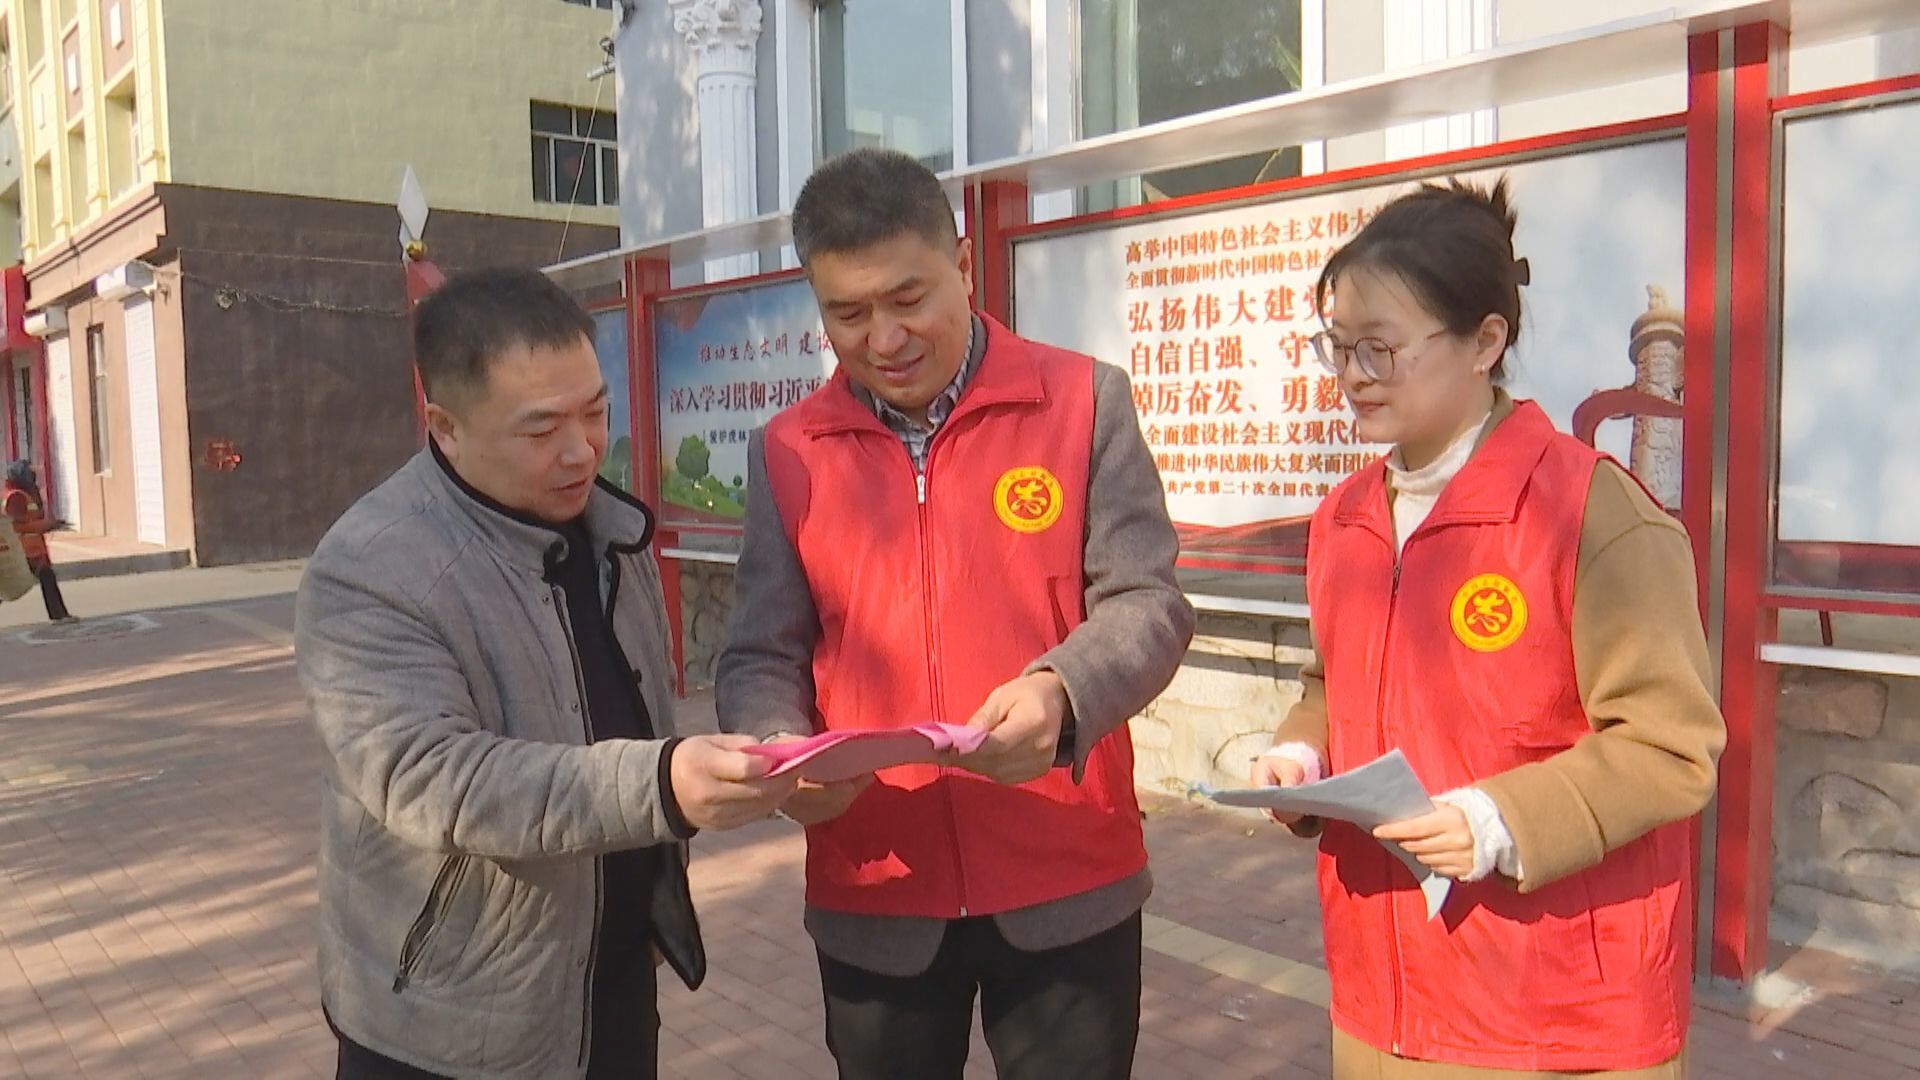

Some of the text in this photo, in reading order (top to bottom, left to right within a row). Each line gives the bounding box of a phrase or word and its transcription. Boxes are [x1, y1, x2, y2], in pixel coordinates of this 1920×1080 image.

[1125, 206, 1381, 265] 高举中国特色社会主义伟大
[1128, 285, 1334, 332] 弘扬伟大建党
[1131, 330, 1326, 376] 自信自强、守
[669, 377, 832, 414] 深入学习贯彻习近
[1167, 480, 1339, 497] 共产党第二十次全国代表
